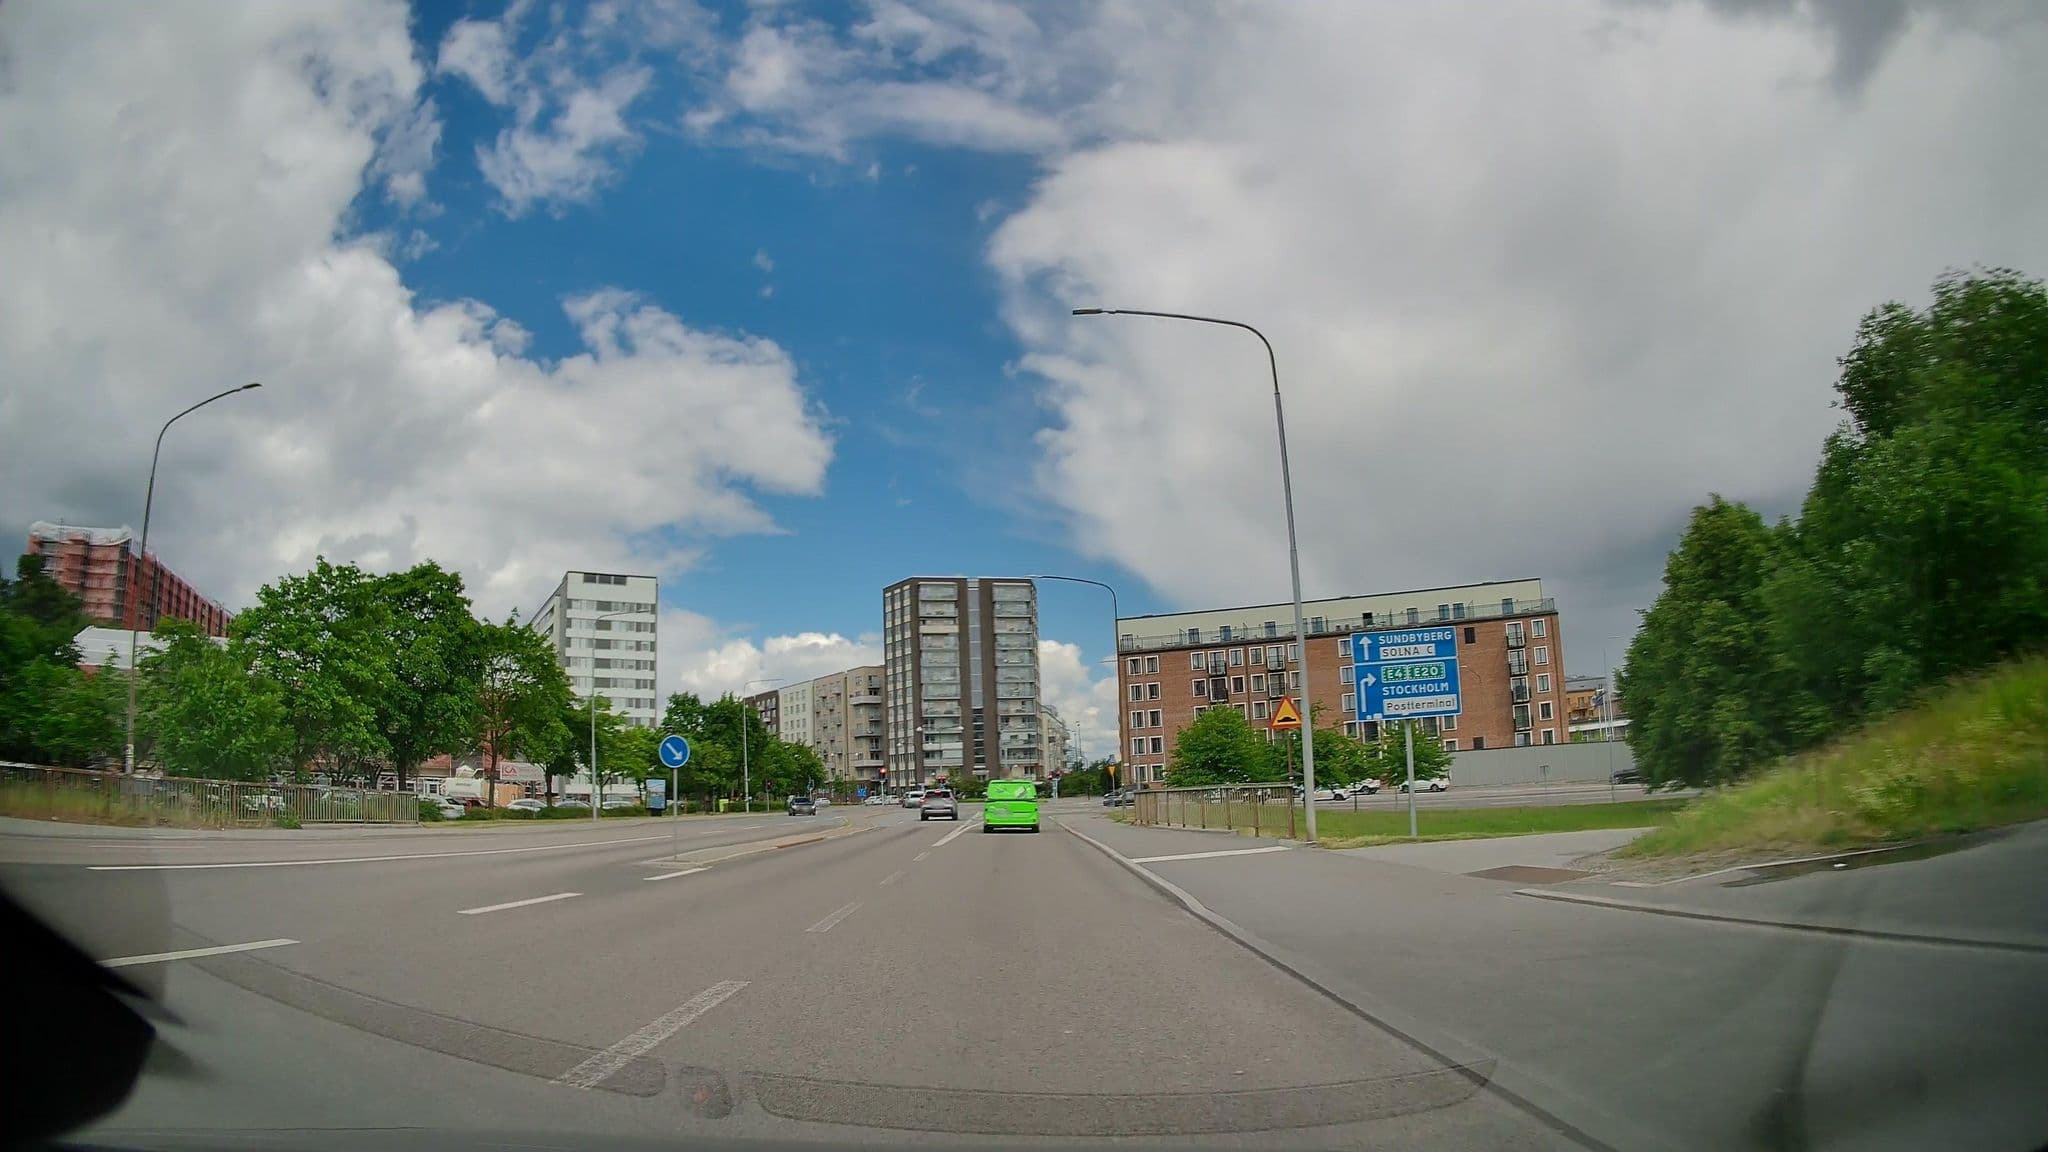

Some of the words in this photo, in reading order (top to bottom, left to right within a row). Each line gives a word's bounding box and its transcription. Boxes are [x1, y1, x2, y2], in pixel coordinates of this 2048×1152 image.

[1378, 631, 1452, 644] SUNDBYBERG
[1382, 646, 1420, 657] SOLNA
[1426, 645, 1433, 654] C
[1387, 669, 1403, 679] E4
[1414, 666, 1439, 677] E20
[1382, 682, 1449, 696] STOCKHOLM
[1386, 699, 1455, 711] Postterminal
